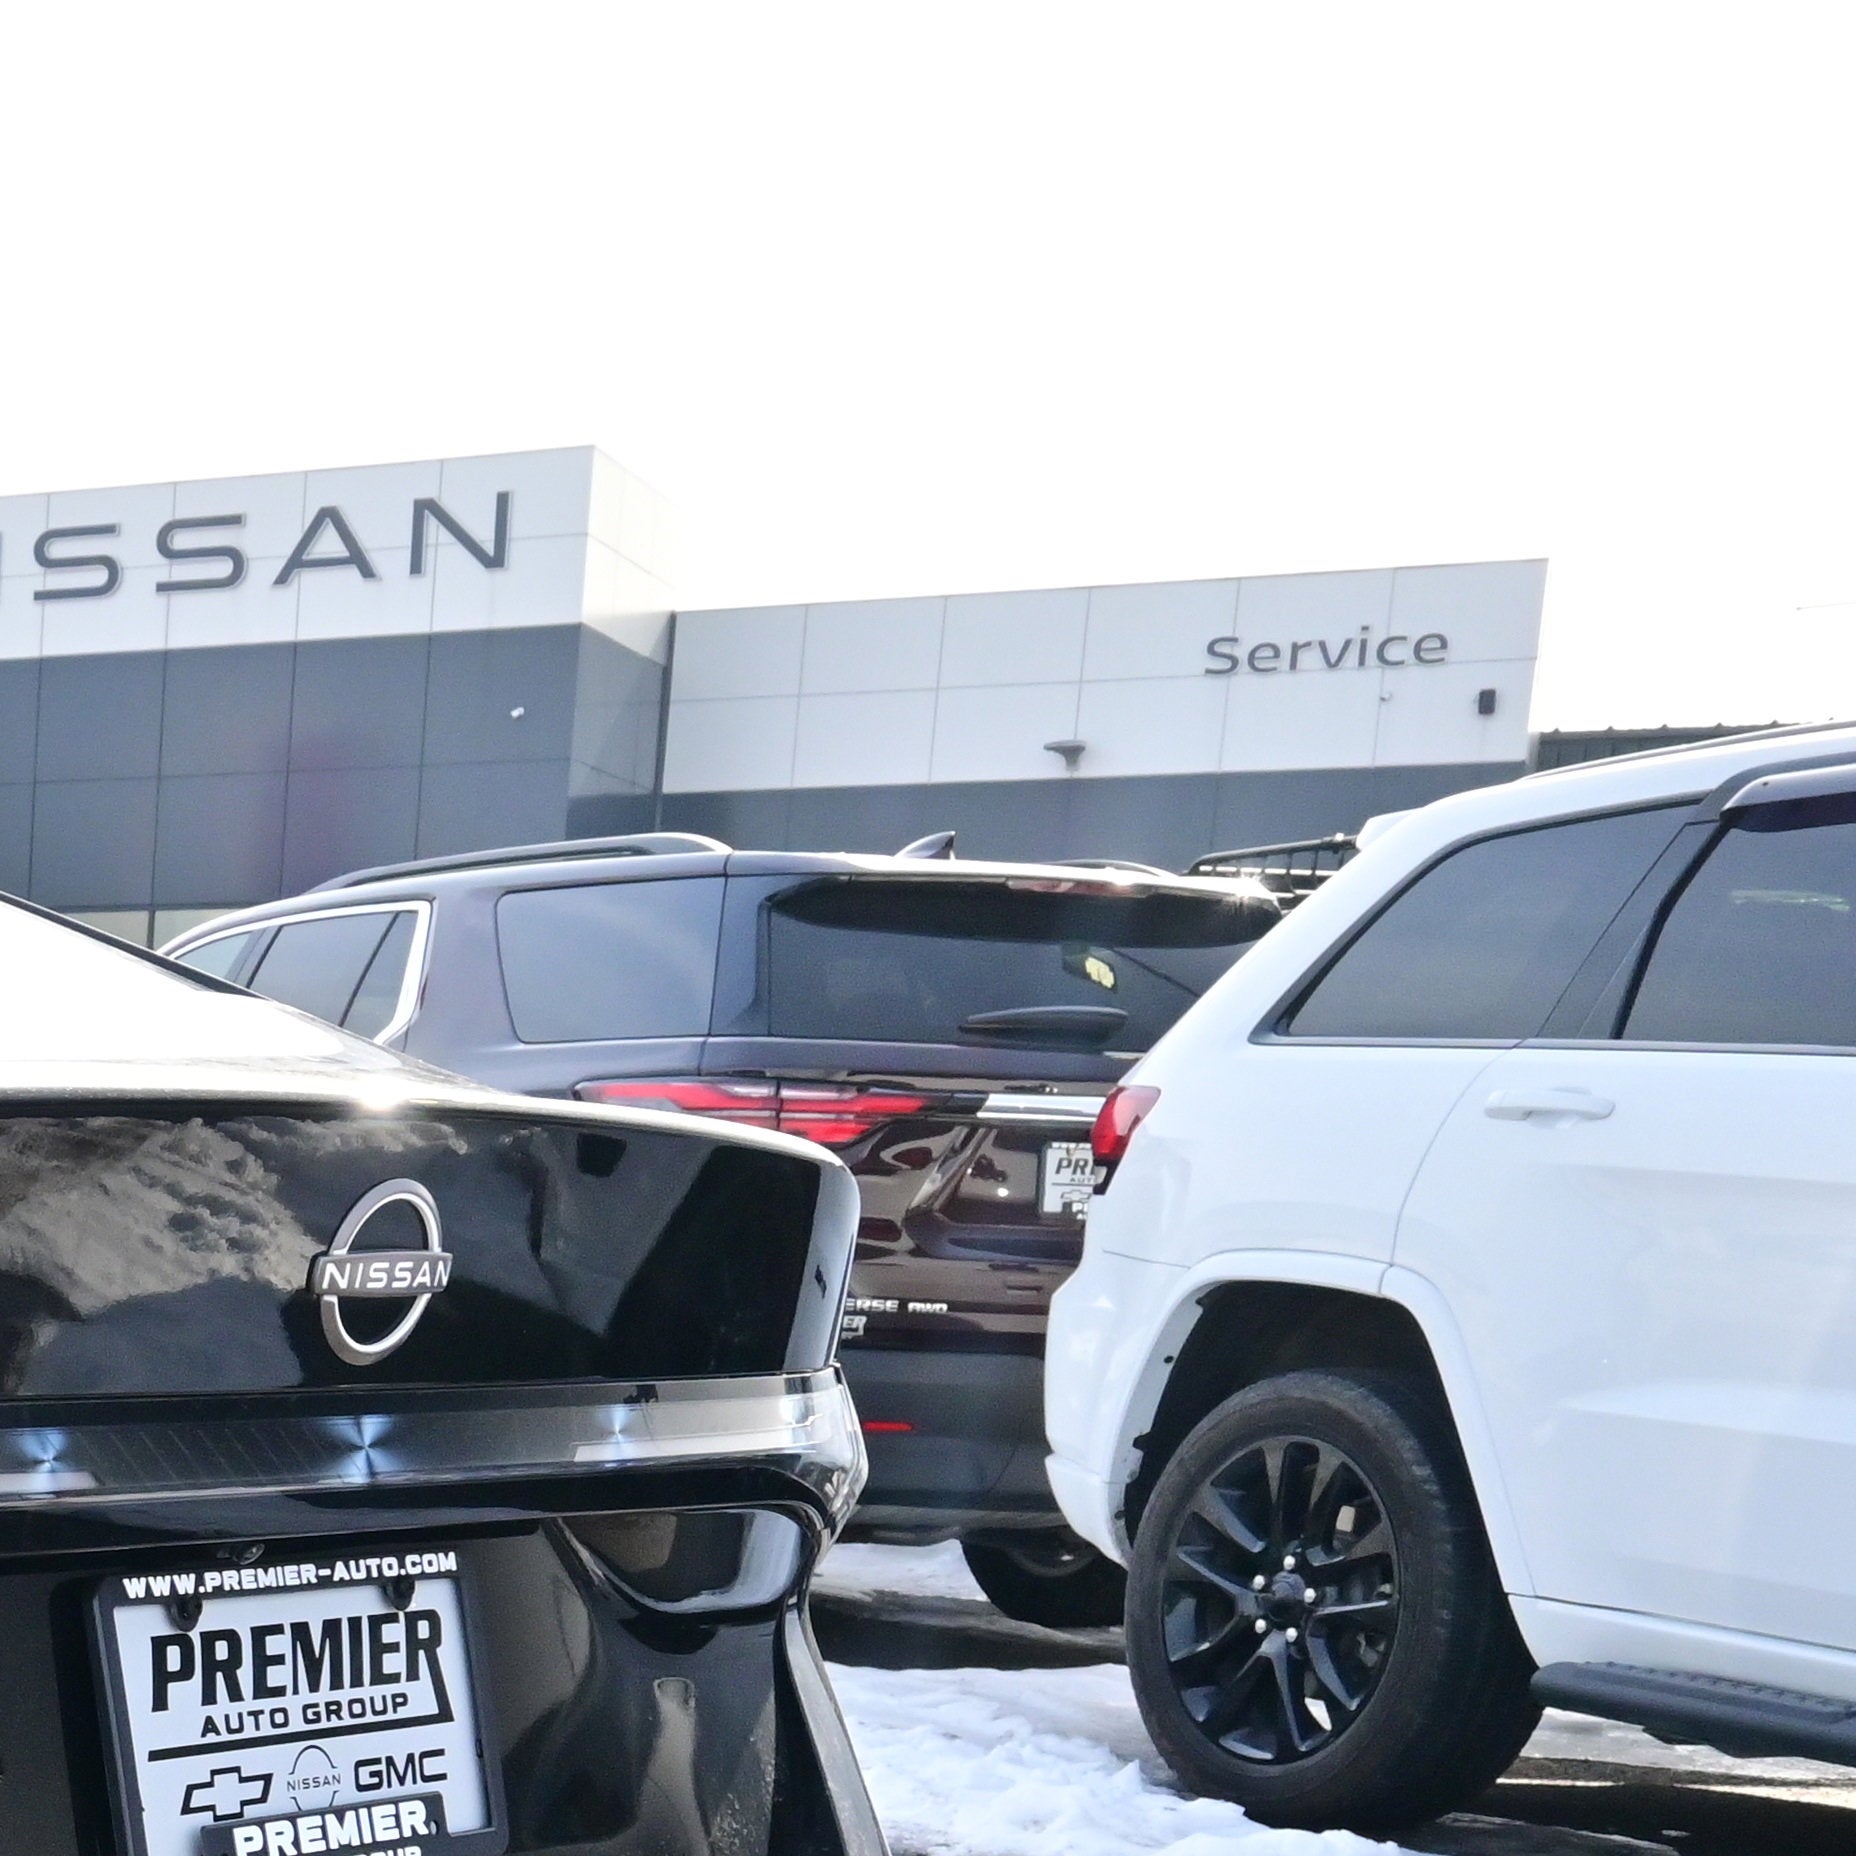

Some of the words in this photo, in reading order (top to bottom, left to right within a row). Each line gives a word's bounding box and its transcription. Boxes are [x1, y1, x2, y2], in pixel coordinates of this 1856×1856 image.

[1204, 625, 1450, 676] Service
[322, 1257, 450, 1291] NISSAN
[123, 1551, 458, 1599] WWW.PREMIER-AUTO.COM
[149, 1608, 448, 1714] PREMIER
[200, 1706, 289, 1738] AUTO
[301, 1691, 410, 1724] GROUP
[286, 1772, 342, 1793] NISSAN
[353, 1748, 448, 1793] GMC
